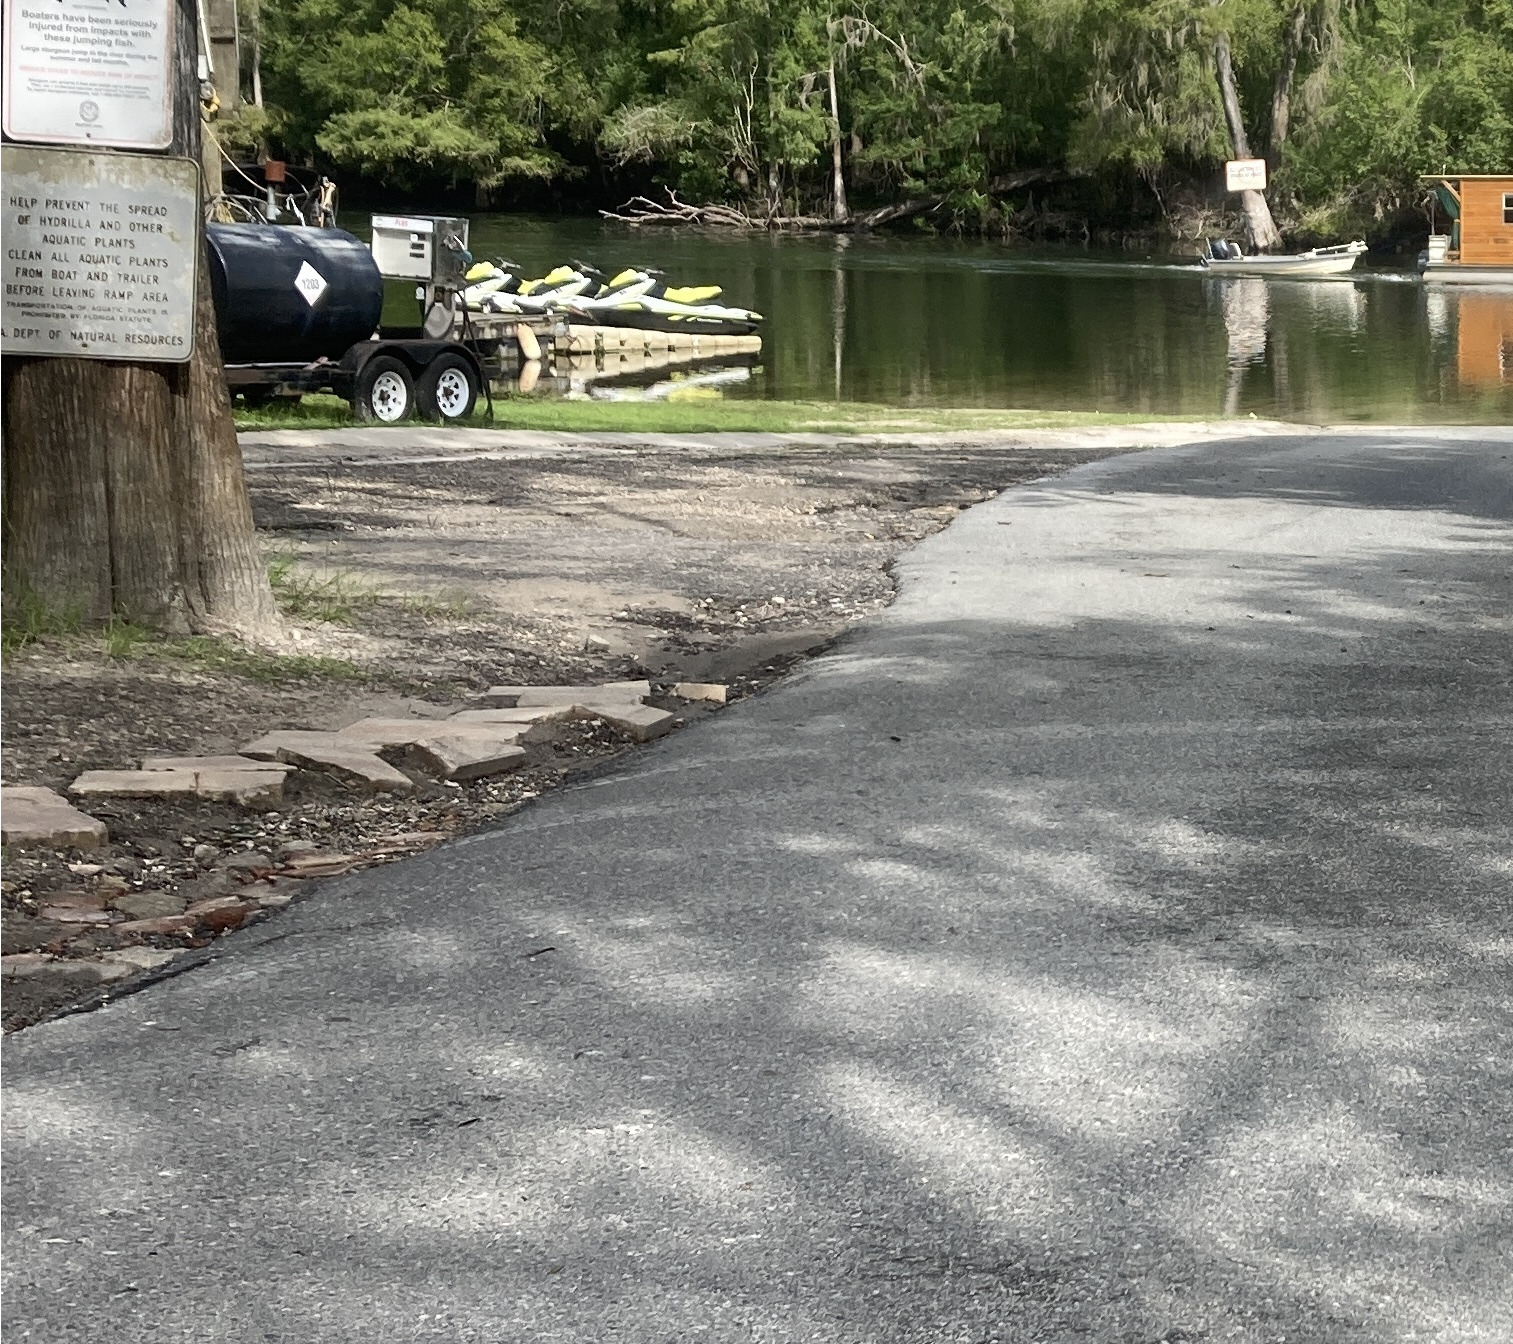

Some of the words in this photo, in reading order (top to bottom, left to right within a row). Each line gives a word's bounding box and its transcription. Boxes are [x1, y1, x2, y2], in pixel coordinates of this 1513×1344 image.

[21, 10, 60, 20] Boaters
[63, 13, 85, 22] have
[88, 14, 112, 24] been
[114, 18, 158, 29] seriously
[66, 24, 88, 33] from
[91, 26, 128, 36] impacts
[44, 33, 70, 42] these
[72, 36, 112, 47] jumping
[10, 197, 37, 208] HELP
[45, 198, 90, 211] PREVENT
[100, 203, 119, 214] THE
[129, 205, 167, 216] SPREAD
[17, 215, 31, 225] OF
[40, 215, 90, 229] HYDRILLA
[99, 221, 120, 231] AND
[129, 222, 163, 233] OTHER
[42, 234, 86, 246] AQUATIC
[95, 237, 135, 249] PLANTS
[8, 249, 42, 260] CLEAN
[51, 252, 69, 262] ALL
[79, 254, 121, 266] AQUATIC
[129, 257, 168, 268] PLANTS
[15, 267, 43, 278] FROM
[52, 269, 77, 280] BOAT
[86, 271, 108, 282] AND
[118, 273, 159, 285] TRAILER
[302, 279, 320, 290] 1203
[6, 284, 45, 296] BEFORE
[53, 286, 95, 298] LEAVING
[104, 289, 133, 301] RAMP
[142, 292, 168, 302] AREA
[49, 329, 63, 339] OF
[70, 331, 118, 343] NATURAL
[125, 334, 183, 346] RESOURCES
